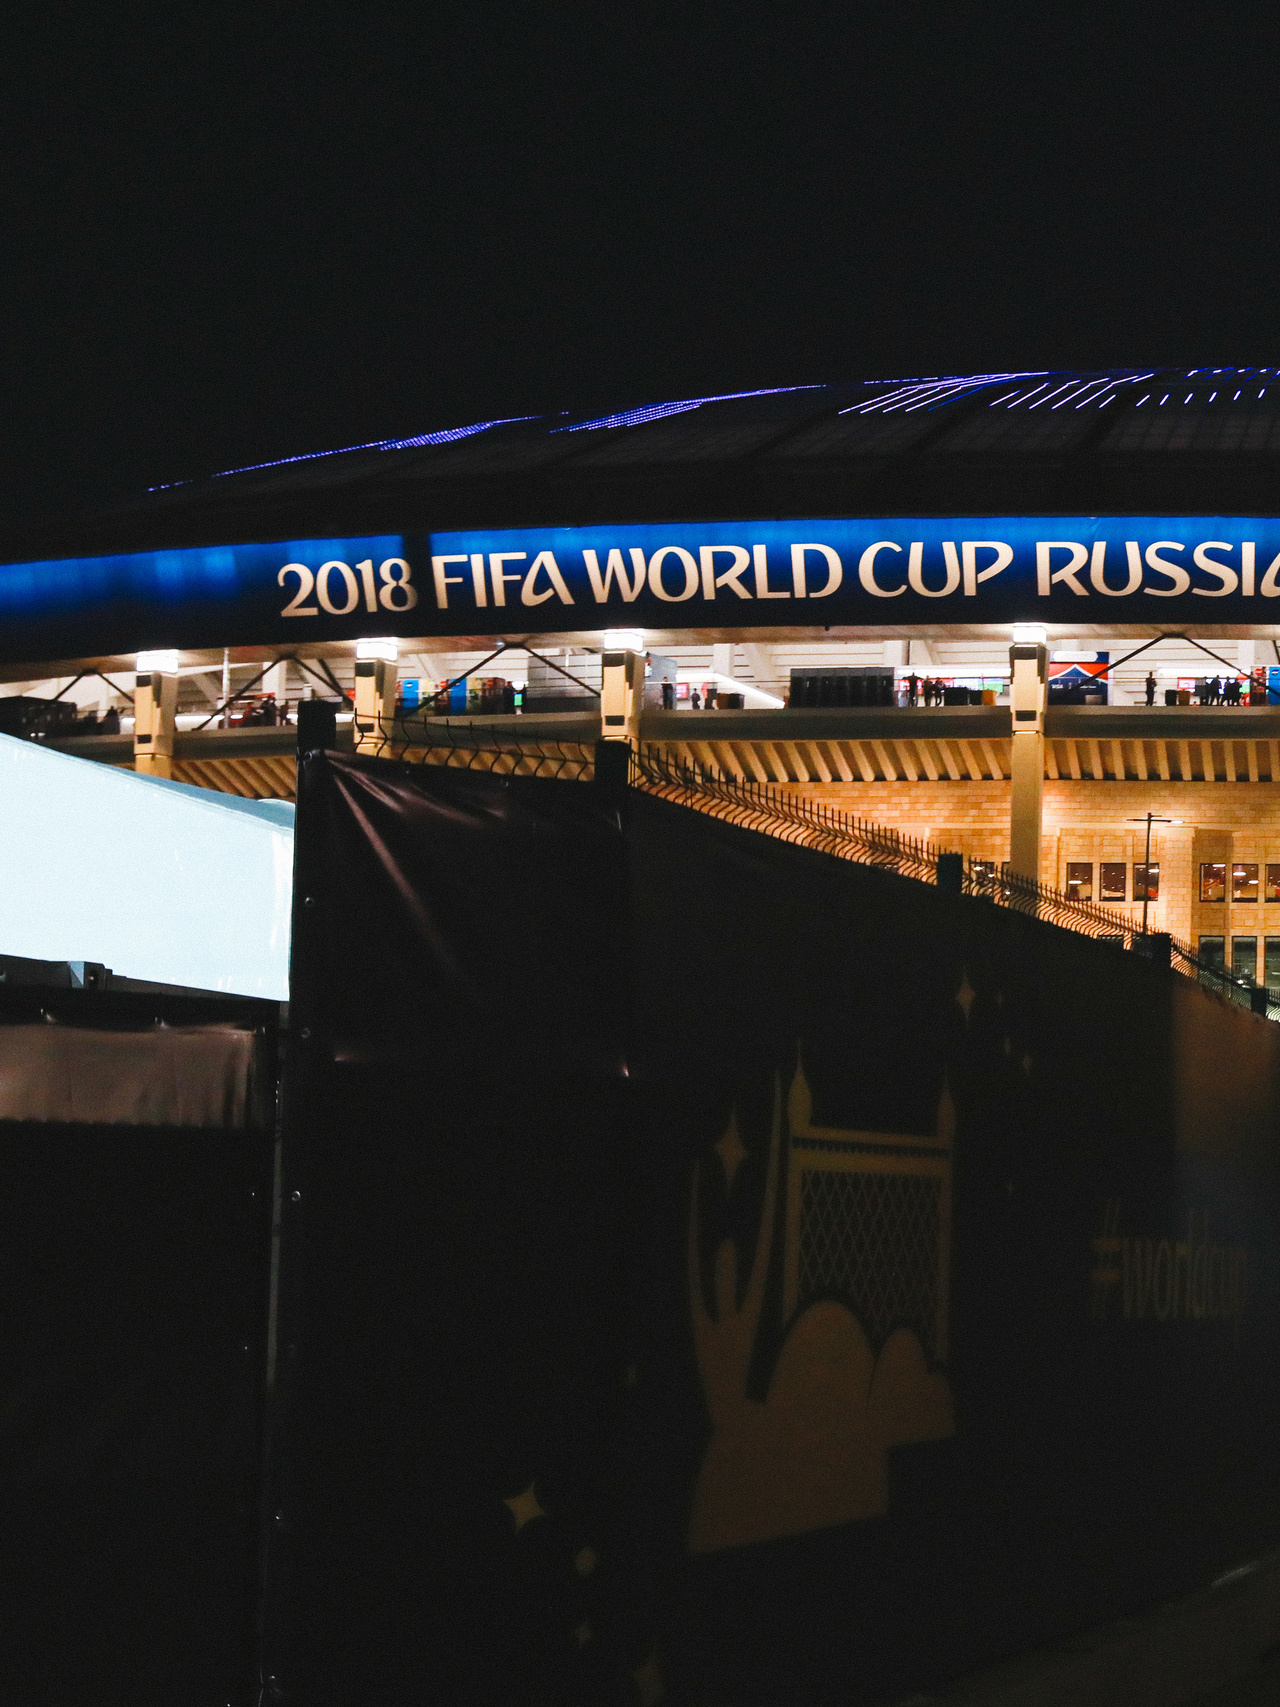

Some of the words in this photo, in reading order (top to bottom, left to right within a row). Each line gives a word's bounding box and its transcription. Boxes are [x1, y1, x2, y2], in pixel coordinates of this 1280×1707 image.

[277, 556, 417, 618] 2018
[430, 550, 576, 610] FIFA
[582, 542, 844, 604] WORLD
[858, 540, 1015, 598] CUP
